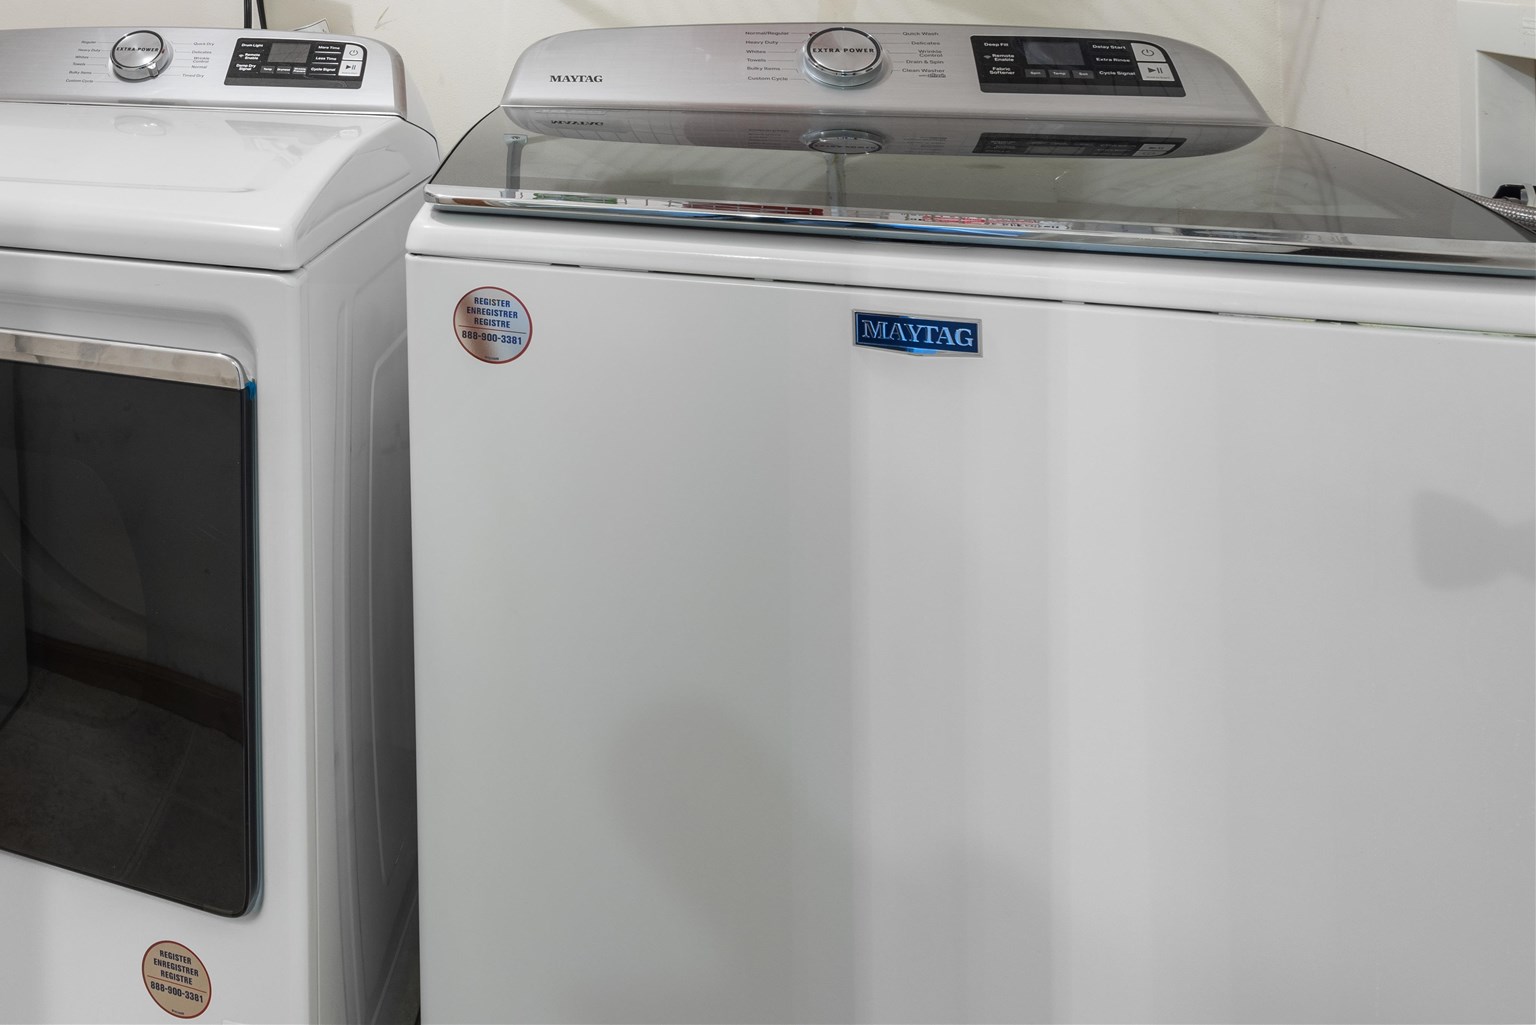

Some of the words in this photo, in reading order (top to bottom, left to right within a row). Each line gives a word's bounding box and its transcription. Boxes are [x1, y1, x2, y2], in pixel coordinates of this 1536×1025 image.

[549, 74, 603, 83] MAYTAG
[474, 297, 511, 308] REGISTER
[466, 306, 518, 319] ENREGISTRER
[474, 317, 511, 328] REGISTRE
[461, 330, 522, 345] 888-900-3381
[861, 319, 974, 347] MAYTAG
[159, 949, 192, 965] REGISTER
[153, 957, 199, 977] ENREGISTRER
[160, 969, 193, 986] REGISTRE
[150, 981, 203, 1003] 888-900-3381
